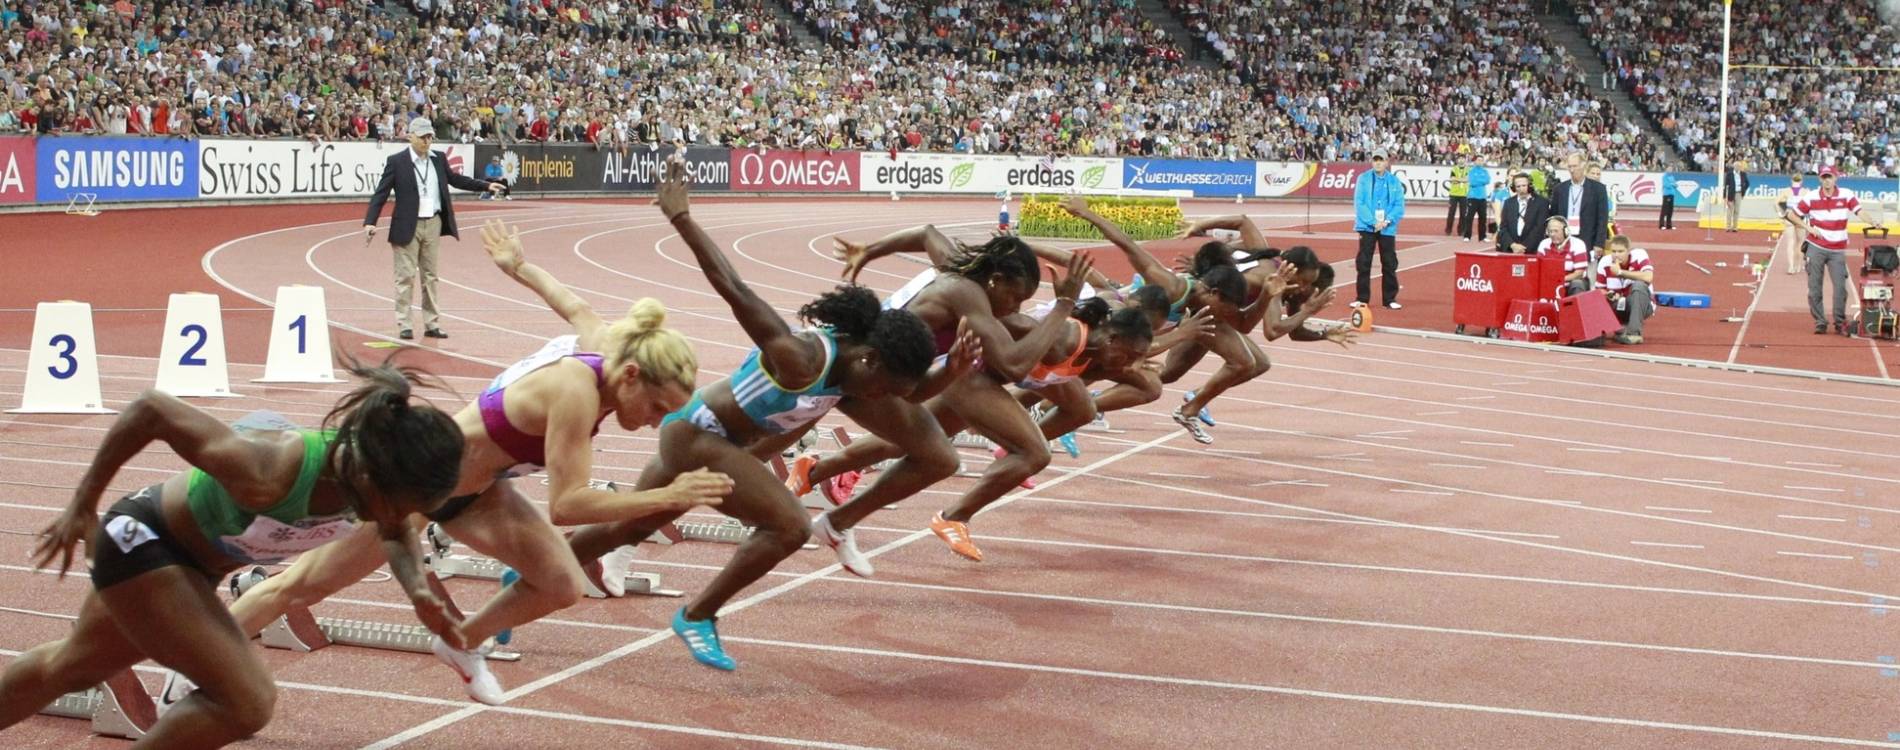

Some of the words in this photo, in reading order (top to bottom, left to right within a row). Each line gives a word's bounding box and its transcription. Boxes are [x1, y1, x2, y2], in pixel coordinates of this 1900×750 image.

[0, 151, 25, 193] A
[54, 149, 184, 189] SAMSUNG
[200, 146, 281, 195] Swiss
[290, 144, 344, 193] Life
[354, 163, 385, 192] Sw
[521, 154, 574, 184] Implenia
[602, 151, 729, 184] All-Athles.com
[770, 159, 851, 185] OMEGA
[876, 161, 944, 189] erdgas
[1007, 164, 1075, 188] erdgas
[1456, 278, 1494, 293] OMEGA
[288, 315, 306, 354] 1
[1504, 321, 1528, 332] OMEGA
[1530, 324, 1559, 334] OMEGA
[48, 334, 78, 380] 3
[178, 324, 208, 366] 2
[122, 519, 138, 544] 9
